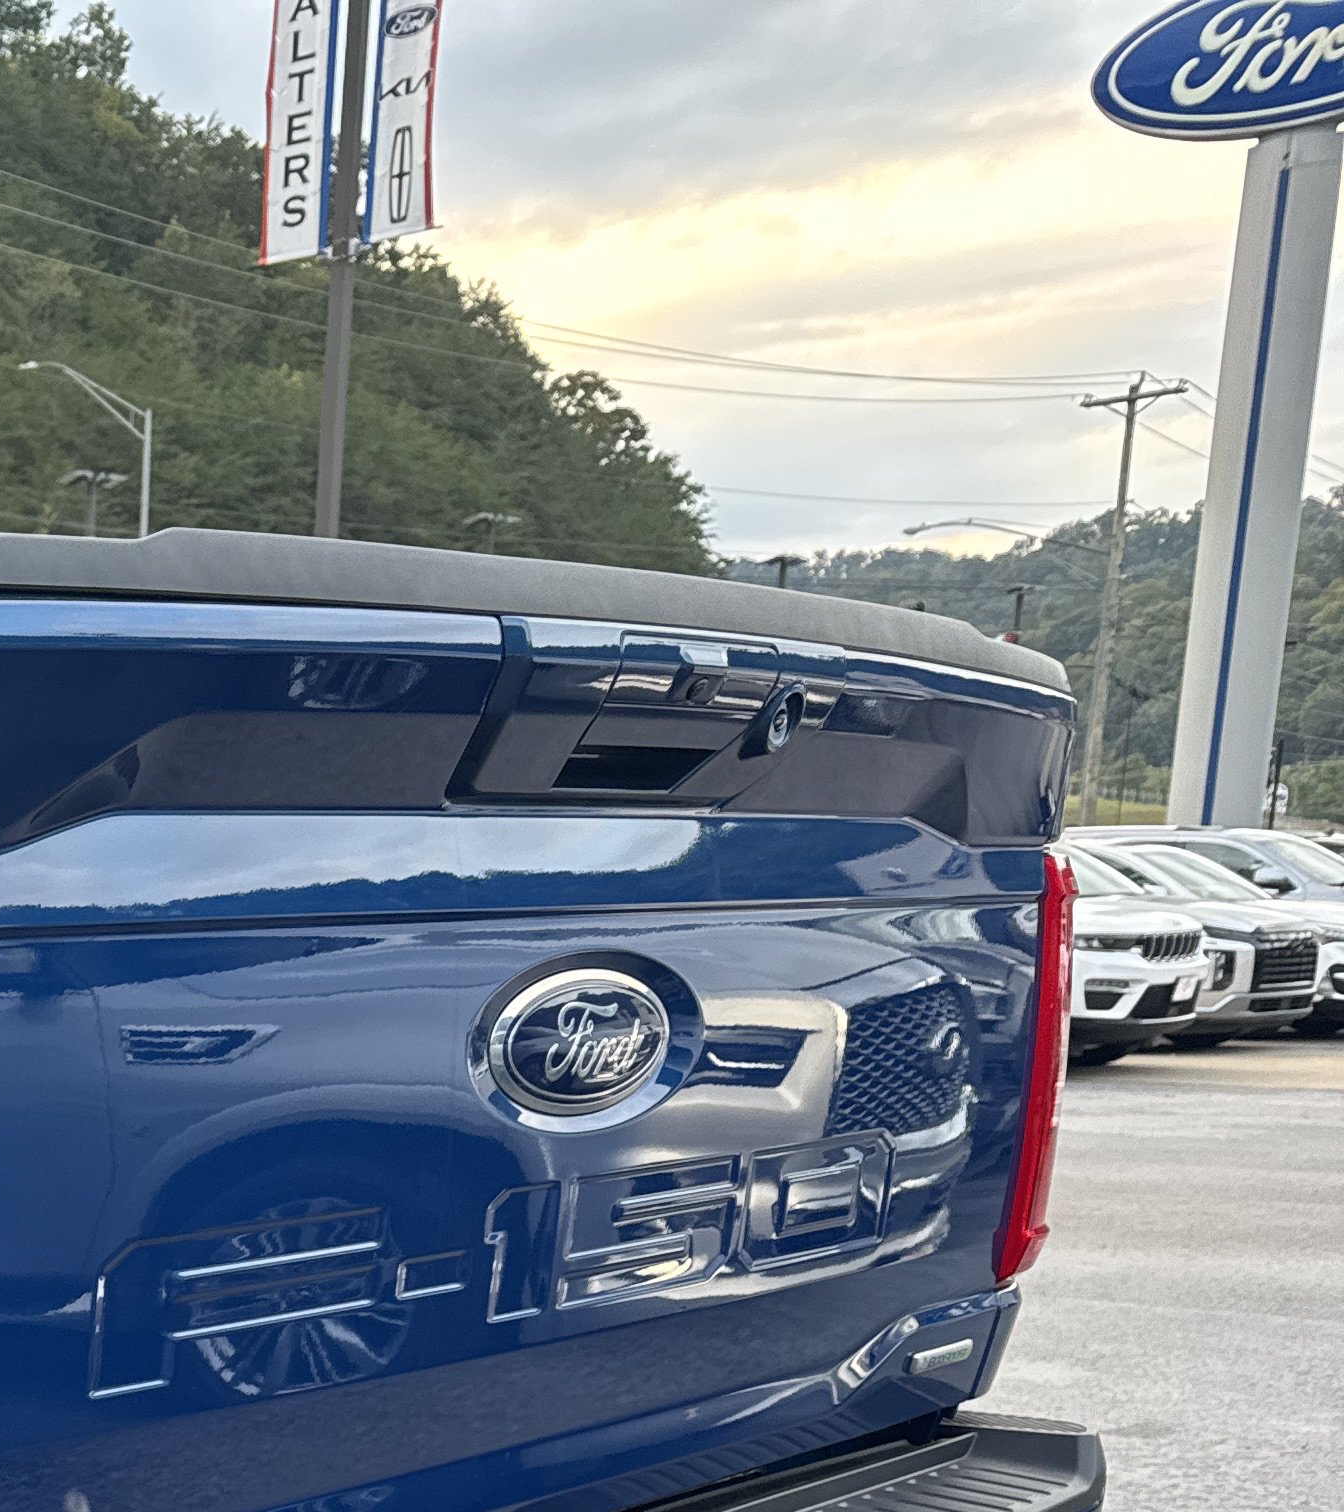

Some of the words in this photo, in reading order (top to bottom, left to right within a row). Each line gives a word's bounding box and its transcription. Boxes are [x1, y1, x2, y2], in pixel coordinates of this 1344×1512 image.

[390, 7, 432, 34] Ford
[544, 1001, 646, 1084] Ford
[88, 1127, 899, 1399] F-150
